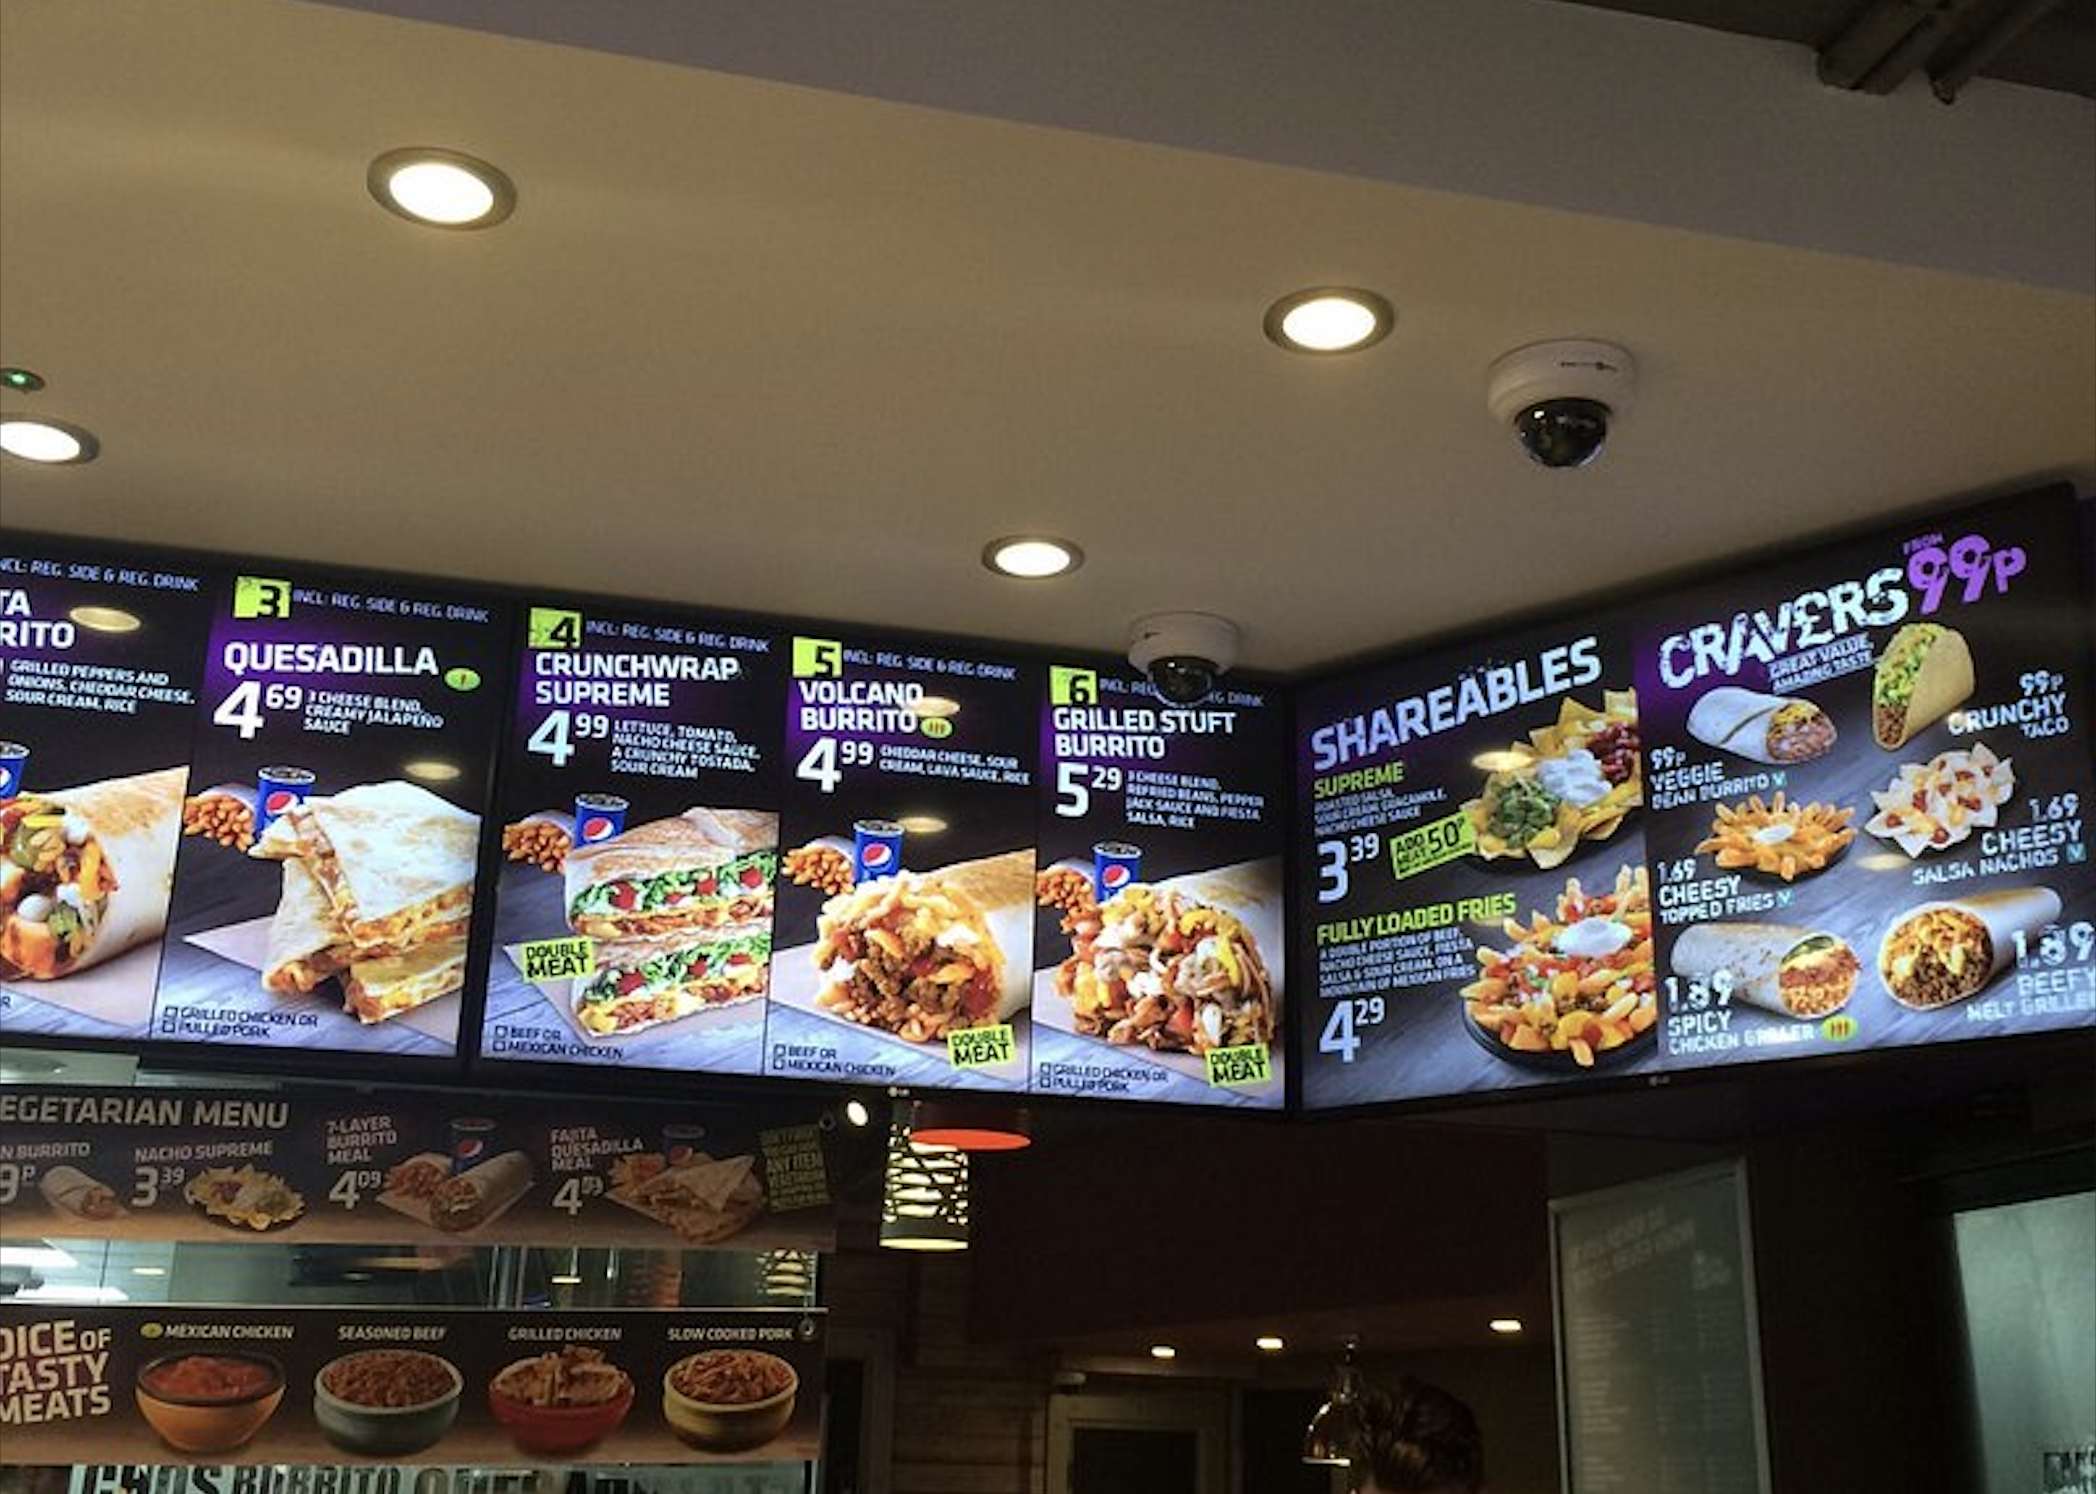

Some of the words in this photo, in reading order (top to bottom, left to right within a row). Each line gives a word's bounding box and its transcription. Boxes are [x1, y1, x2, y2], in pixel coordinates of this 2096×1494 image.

[152, 574, 199, 592] DRINK
[259, 584, 278, 616] 3
[446, 606, 488, 622] DRINK
[550, 617, 577, 642] 4
[1659, 567, 1908, 690] CRAVERS
[729, 635, 770, 652] DRINK
[224, 641, 439, 676] QUESADILLA
[535, 651, 742, 681] CRUNCHWRAP
[815, 645, 835, 676] 5
[9, 659, 70, 677] GRILLED
[71, 663, 135, 683] PEPPERS
[136, 671, 170, 686] AND
[69, 679, 137, 698] CHEDDAR
[535, 680, 671, 708] SUPREME
[798, 681, 924, 705] VOLCANO
[1070, 675, 1091, 704] 6
[6, 688, 46, 704] SOUR
[103, 698, 136, 714] RICE
[318, 691, 372, 711] CHEESE
[1311, 636, 1602, 771] SHAREABLES
[305, 704, 366, 721] CREAMY
[800, 705, 918, 733] BURRITO
[1053, 707, 1156, 733] GRILLED
[1160, 709, 1238, 734] STUFT
[1947, 691, 2067, 736] CRUNCHY
[303, 717, 351, 736] SAUCE
[2020, 716, 2069, 738] TACO
[612, 733, 661, 749] NACHO
[662, 737, 712, 754] CHEESE
[1055, 733, 1166, 759] BURRITO
[624, 749, 687, 766] CRUNCHY
[880, 744, 937, 761] CHEDDAR
[986, 755, 1018, 769] SOUR
[611, 759, 648, 774] SOUR
[649, 763, 699, 780] CREAM
[926, 763, 960, 778] LAVA
[1314, 761, 1404, 799] SUPREME
[1650, 761, 1725, 792] VEGGIE
[1652, 789, 1697, 810] BEAN
[1700, 773, 1770, 802] BURRITO
[2030, 793, 2079, 821] 1.69
[1981, 819, 2082, 855] CHEESY
[1658, 859, 1697, 884] 1.69
[1912, 861, 1976, 885] SALSA
[1979, 847, 2060, 876] NACHOS
[1660, 875, 1741, 907] CHEESY
[1317, 915, 1376, 946] FULLY
[1377, 902, 1454, 935] LOADED
[1455, 892, 1516, 922] FRIES
[1659, 901, 1722, 925] TOPPED
[1725, 892, 1776, 914] FRIES
[525, 941, 588, 961] DOUBLE
[527, 957, 587, 979] MEAT
[181, 1006, 236, 1021] GRILLED
[239, 1011, 296, 1026] CHICKEN
[299, 1015, 318, 1027] OR
[1966, 1000, 2016, 1022] MELT
[180, 1021, 231, 1036] PULLED
[233, 1025, 270, 1039] PORK
[511, 1027, 541, 1039] BEEF
[542, 1029, 561, 1041] OR
[1668, 1009, 1733, 1037] SPICY
[952, 1027, 1008, 1047] DOUBLE
[1668, 1032, 1739, 1056] CHICKEN
[508, 1041, 567, 1055] MEXICAN
[569, 1043, 624, 1060] CHICKEN
[789, 1045, 819, 1057] BEEF
[820, 1048, 836, 1060] OR
[954, 1043, 1010, 1066] MEAT
[1210, 1047, 1262, 1065] DOUBLE
[788, 1059, 842, 1073] MEXICAN
[844, 1061, 897, 1077] CHICKEN
[1053, 1063, 1101, 1079] GRILLED
[1103, 1067, 1151, 1081] CHICKEN
[1213, 1061, 1266, 1083] MEAT
[0, 1094, 184, 1127] EGETARIAN
[193, 1099, 289, 1129] MENU
[325, 1115, 393, 1135] 7-LAYER
[17, 1142, 91, 1160] BURRITO
[135, 1145, 193, 1162] NACHO
[195, 1140, 274, 1160] SUPREME
[325, 1129, 398, 1151] BURRITO
[551, 1136, 644, 1159] QUESADILLA
[326, 1146, 374, 1164] MEAL
[551, 1157, 593, 1173] MEAL
[165, 1324, 232, 1340] MEXICAN
[232, 1323, 295, 1340] CHICKEN
[337, 1323, 411, 1342] SEASONED
[412, 1324, 447, 1342] BEEF
[508, 1325, 564, 1342] GRILLED
[565, 1325, 623, 1342] CHICKEN
[667, 1326, 706, 1342] SLOW
[707, 1326, 757, 1342] COOKED
[758, 1326, 795, 1342] PORK
[0, 1385, 112, 1425] MEATS
